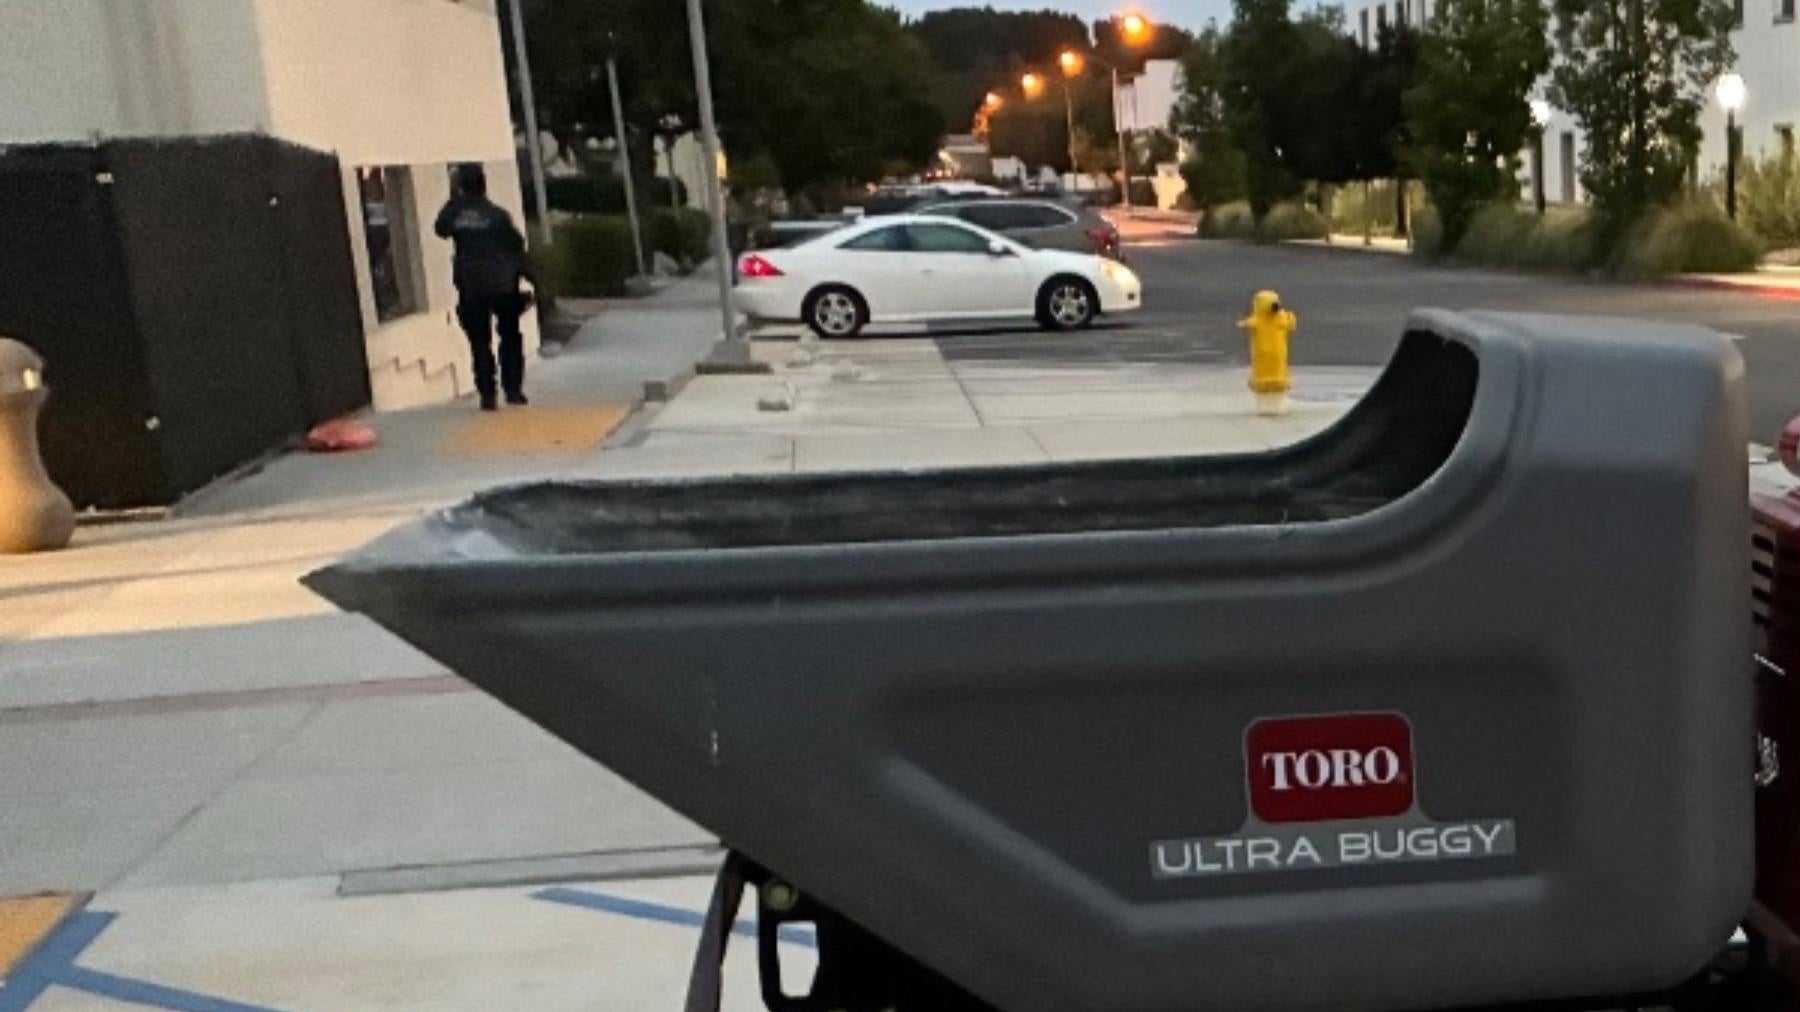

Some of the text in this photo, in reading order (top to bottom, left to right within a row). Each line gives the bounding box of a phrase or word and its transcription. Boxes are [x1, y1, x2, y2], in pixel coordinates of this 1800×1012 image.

[1262, 745, 1400, 791] TORO
[1157, 823, 1503, 874] ULTRA BUGGY
